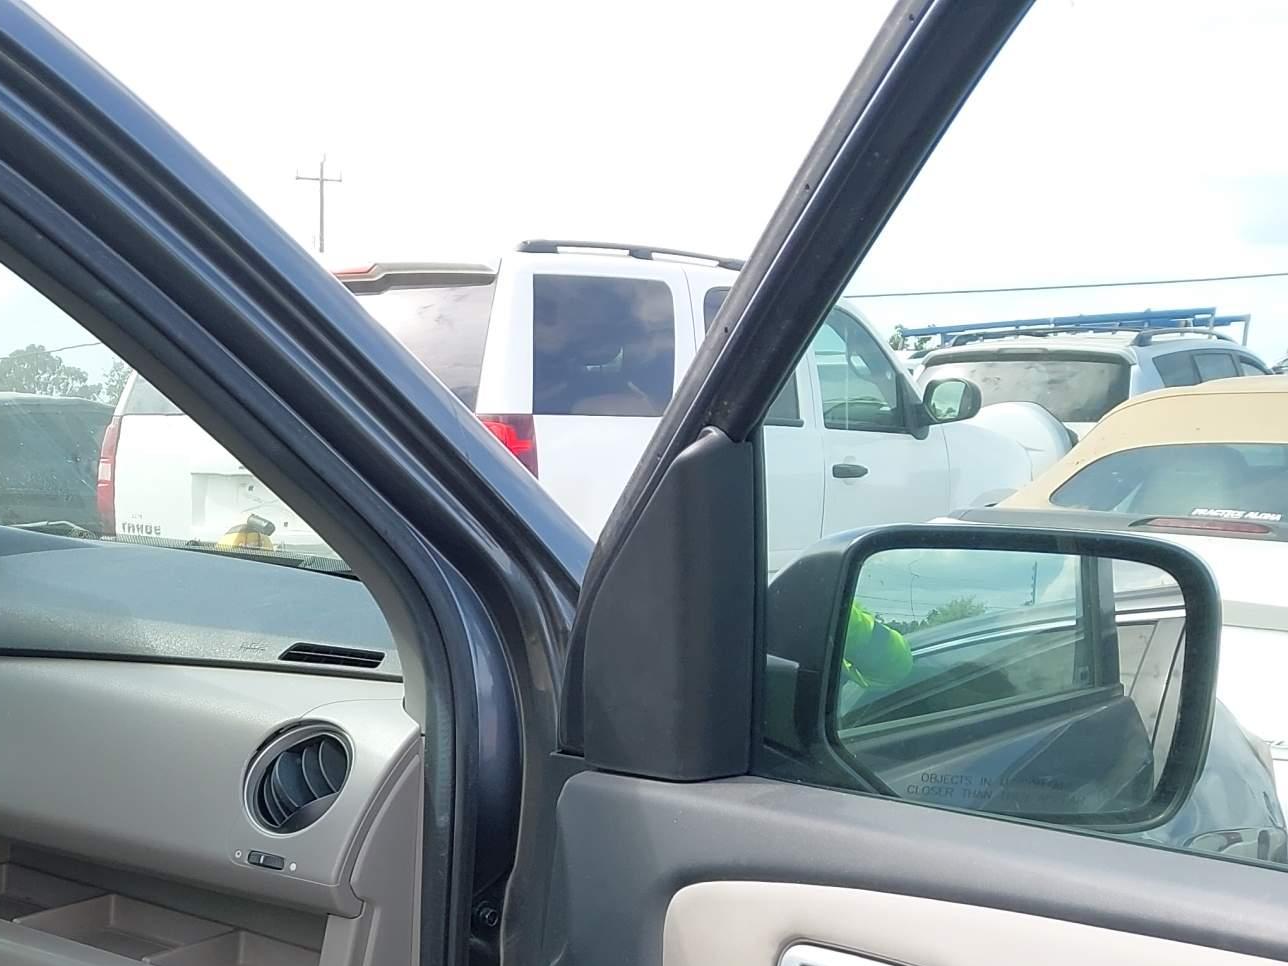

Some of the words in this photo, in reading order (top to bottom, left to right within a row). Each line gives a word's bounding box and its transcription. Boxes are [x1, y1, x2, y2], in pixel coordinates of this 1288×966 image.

[121, 522, 162, 536] TAHOE
[920, 772, 972, 786] OBJECTS
[906, 784, 954, 798] CLOSER
[961, 789, 993, 800] THAN
